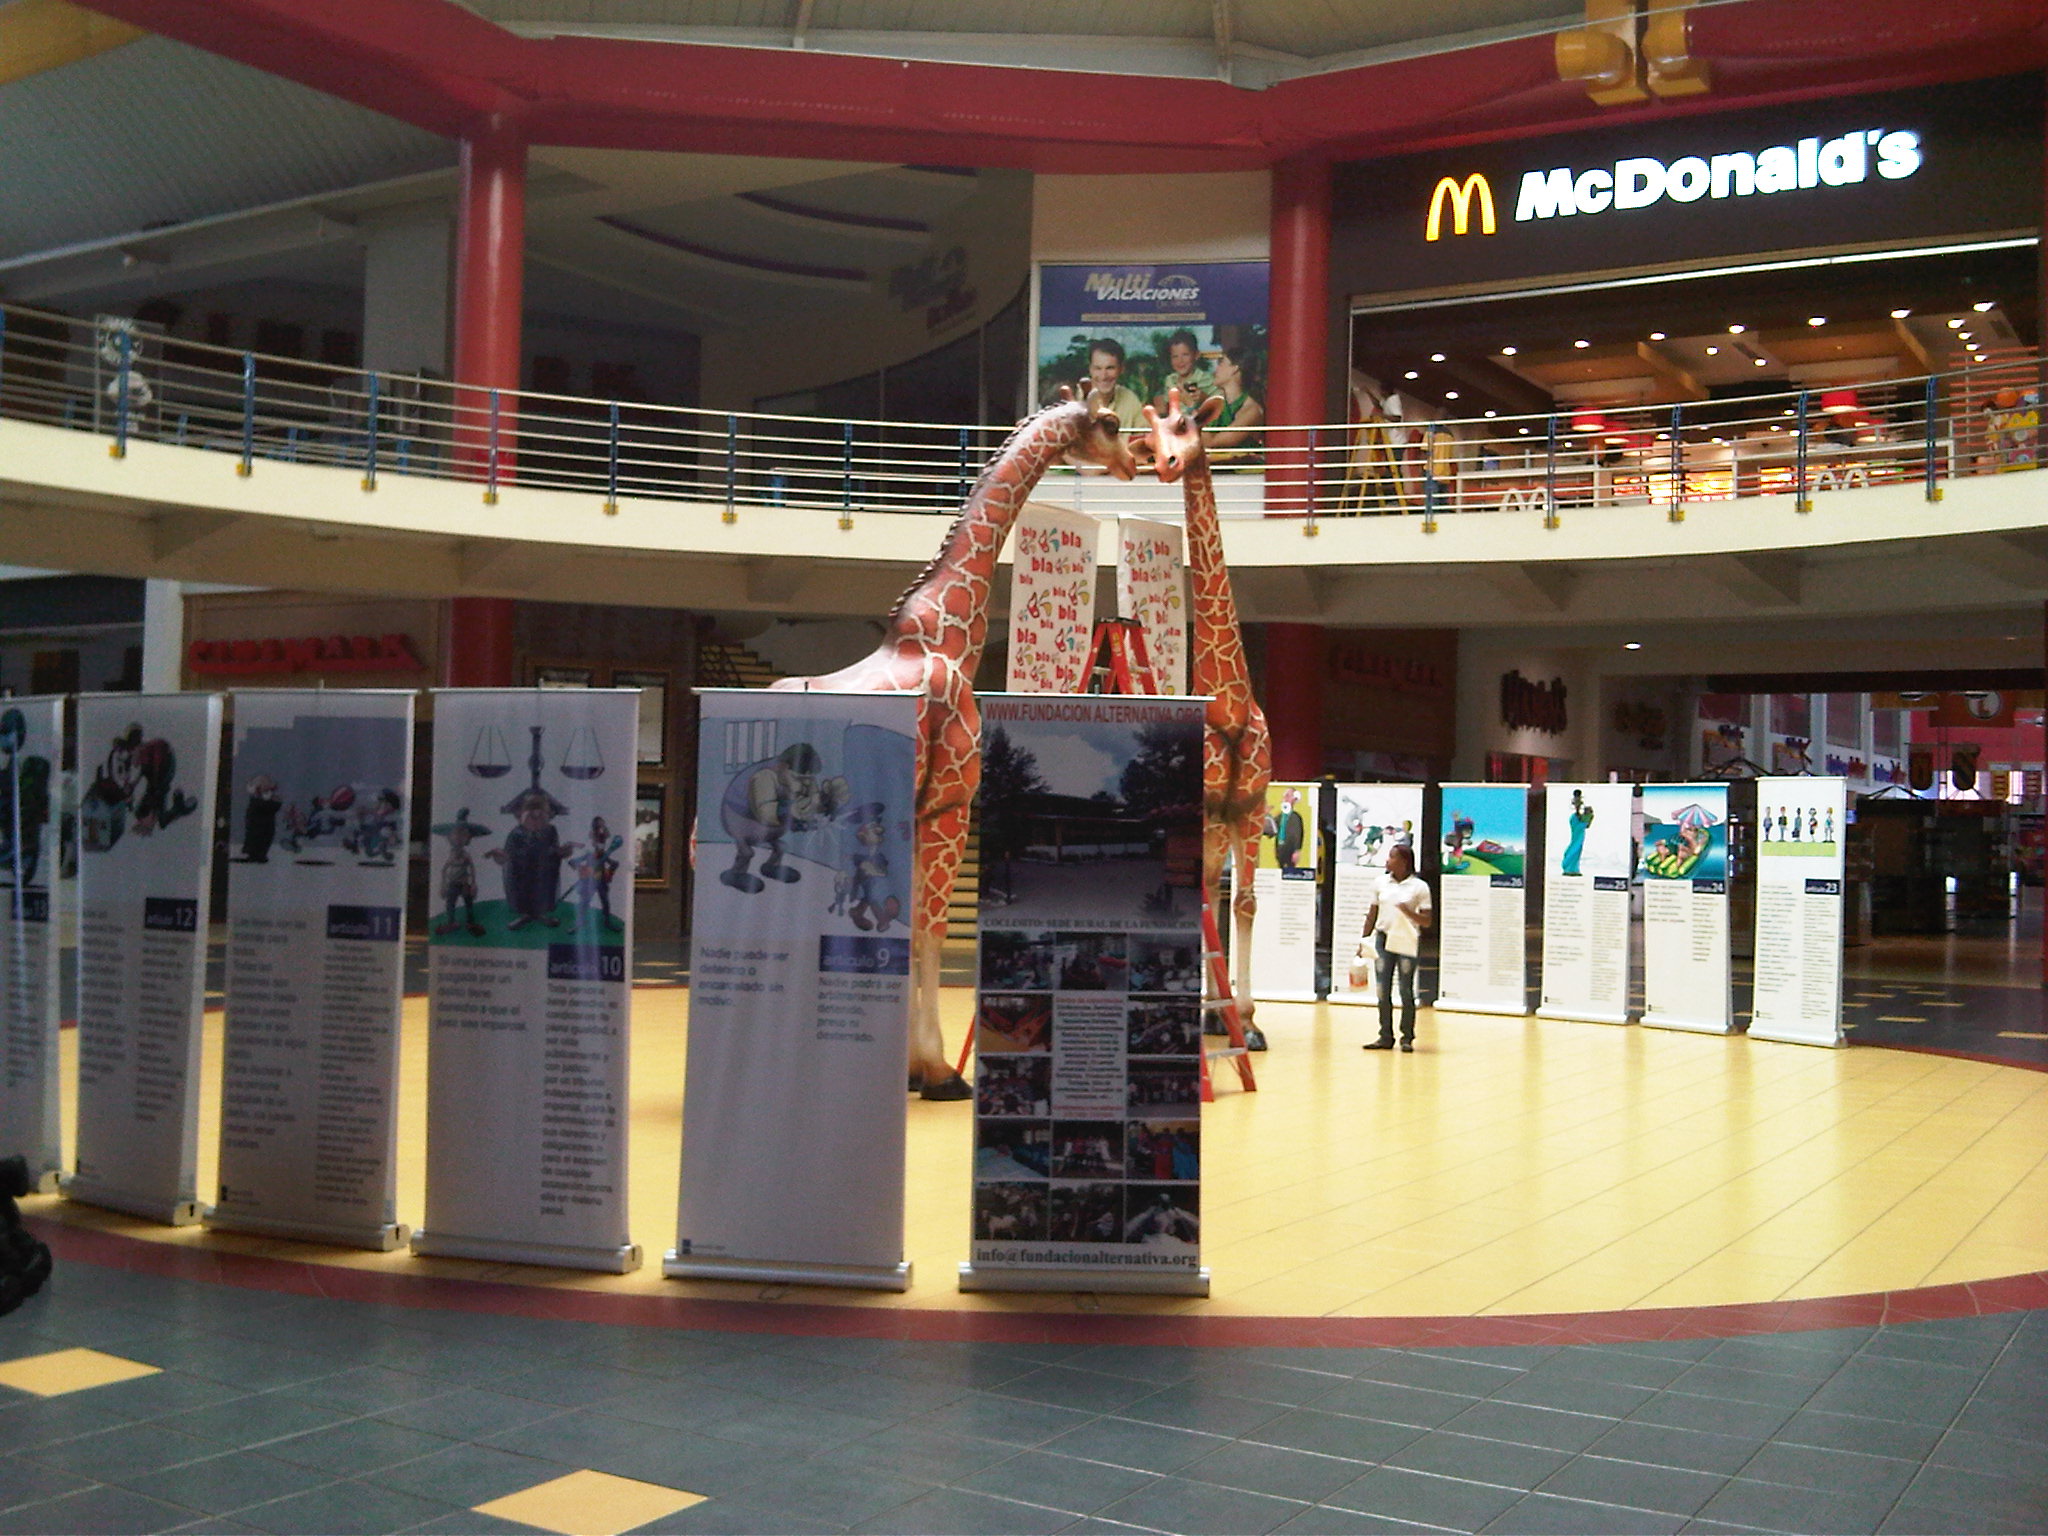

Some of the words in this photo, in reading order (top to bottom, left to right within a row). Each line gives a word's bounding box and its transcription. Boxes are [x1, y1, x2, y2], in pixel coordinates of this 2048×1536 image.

[1514, 128, 1921, 222] McDonald's
[1084, 272, 1151, 292] Multi
[1096, 287, 1200, 301] VACACIONES
[1061, 530, 1082, 548] bla
[1032, 557, 1053, 573] bla
[1058, 605, 1077, 621] bla
[1017, 628, 1037, 645] bla
[985, 703, 1091, 722] WWW.FUNDACION
[1094, 705, 1201, 723] ALTERNATIVA.ORG
[1825, 882, 1837, 893] 23
[176, 906, 193, 928] 12
[373, 915, 393, 936] 11
[601, 955, 621, 975] 10
[876, 948, 891, 968] 9
[976, 1248, 1198, 1268] info@fundacionalternativa.org
